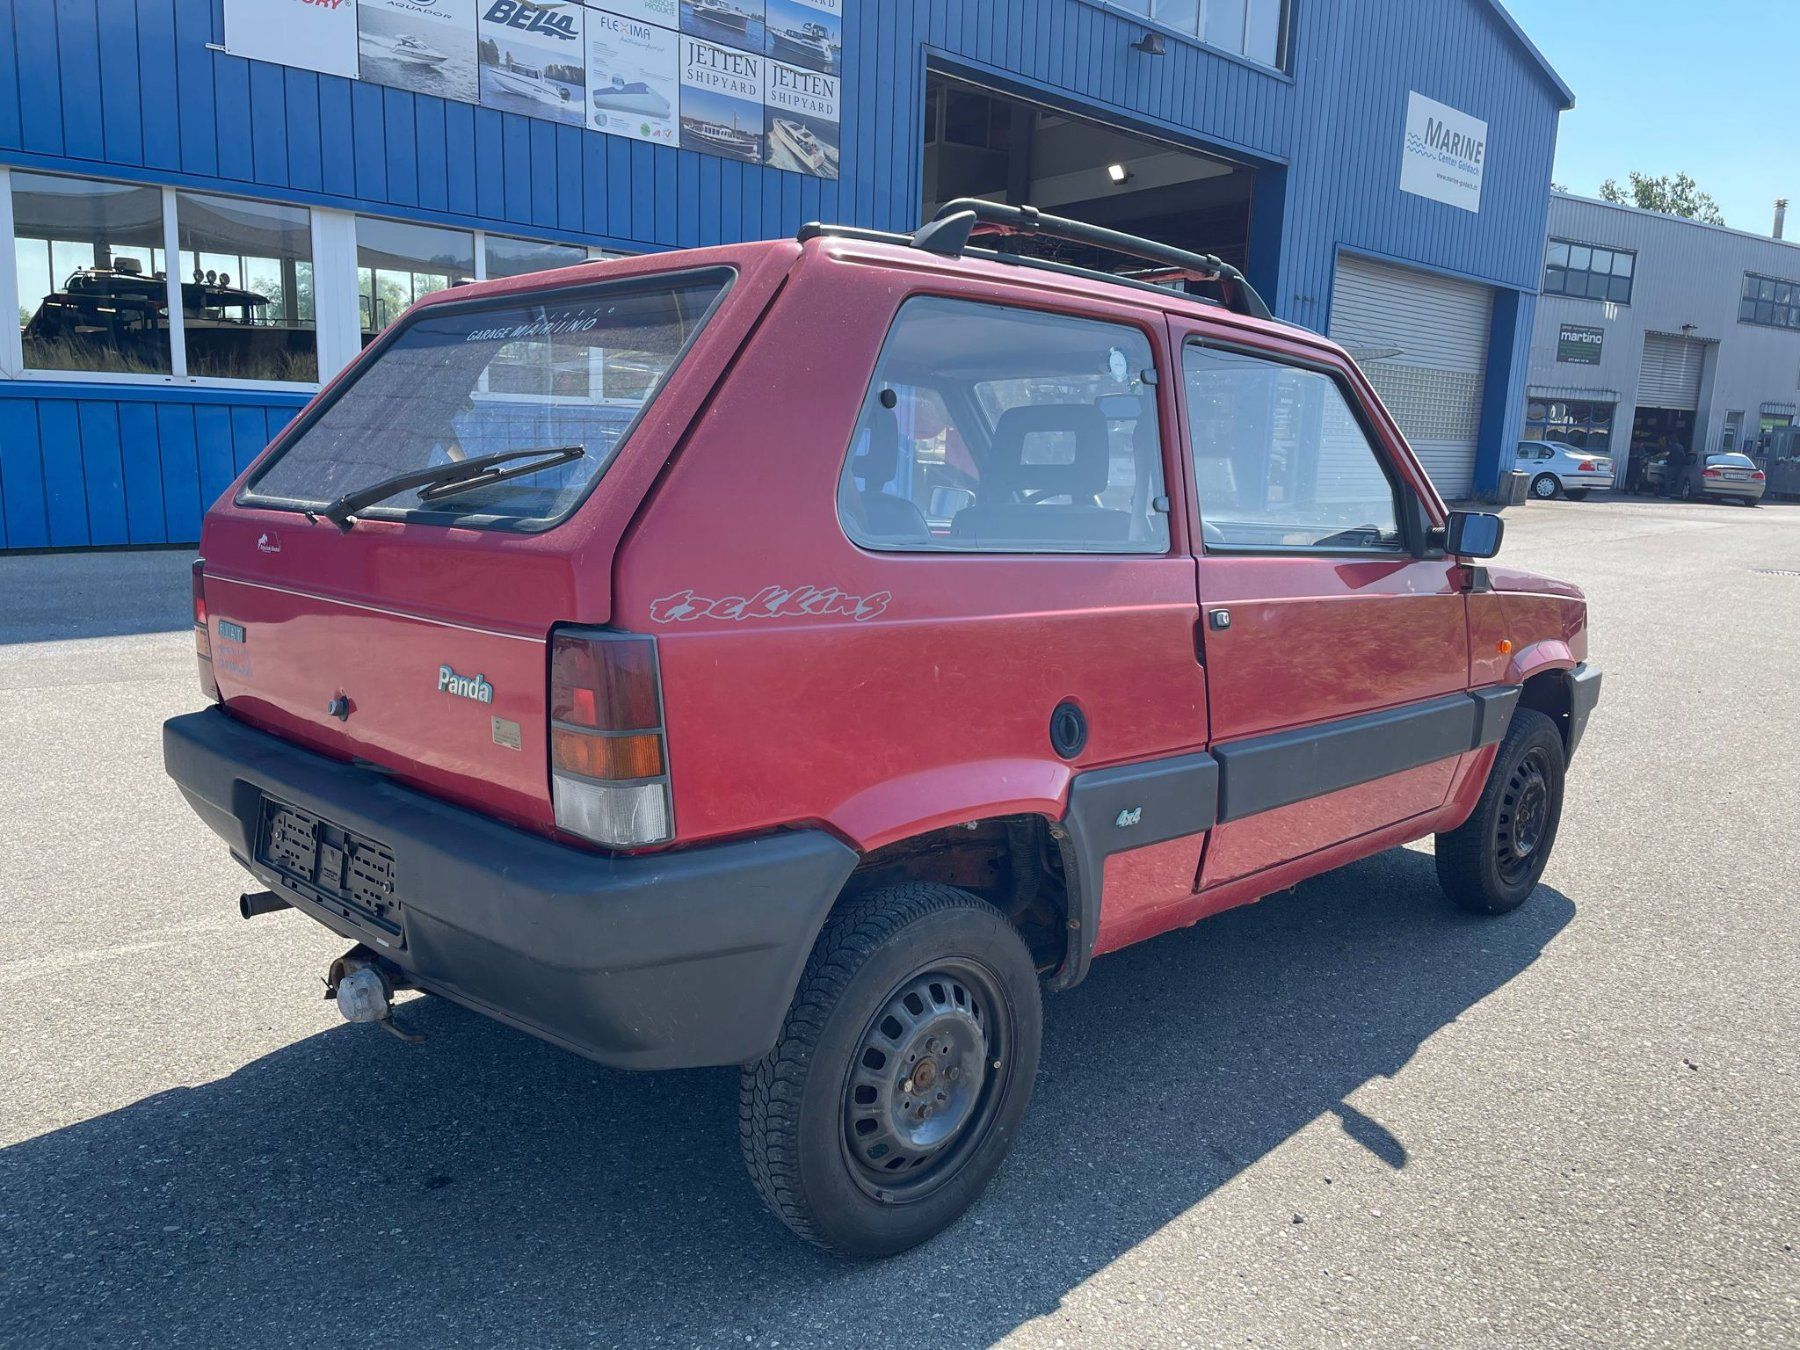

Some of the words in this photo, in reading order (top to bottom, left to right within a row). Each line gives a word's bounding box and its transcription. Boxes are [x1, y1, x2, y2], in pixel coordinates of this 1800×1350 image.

[386, 1, 452, 19] AQUADOR
[483, 0, 579, 40] BELLA
[600, 16, 650, 40] FLEXIMA
[688, 41, 757, 78] JETTEN
[687, 68, 756, 96] SHIPYARD
[772, 65, 835, 98] JETTEN
[771, 90, 833, 115] SHIPYARD
[1424, 117, 1483, 164] MARINE
[466, 326, 511, 341] GARAGE
[1560, 331, 1602, 344] martino
[438, 664, 493, 704] Panda
